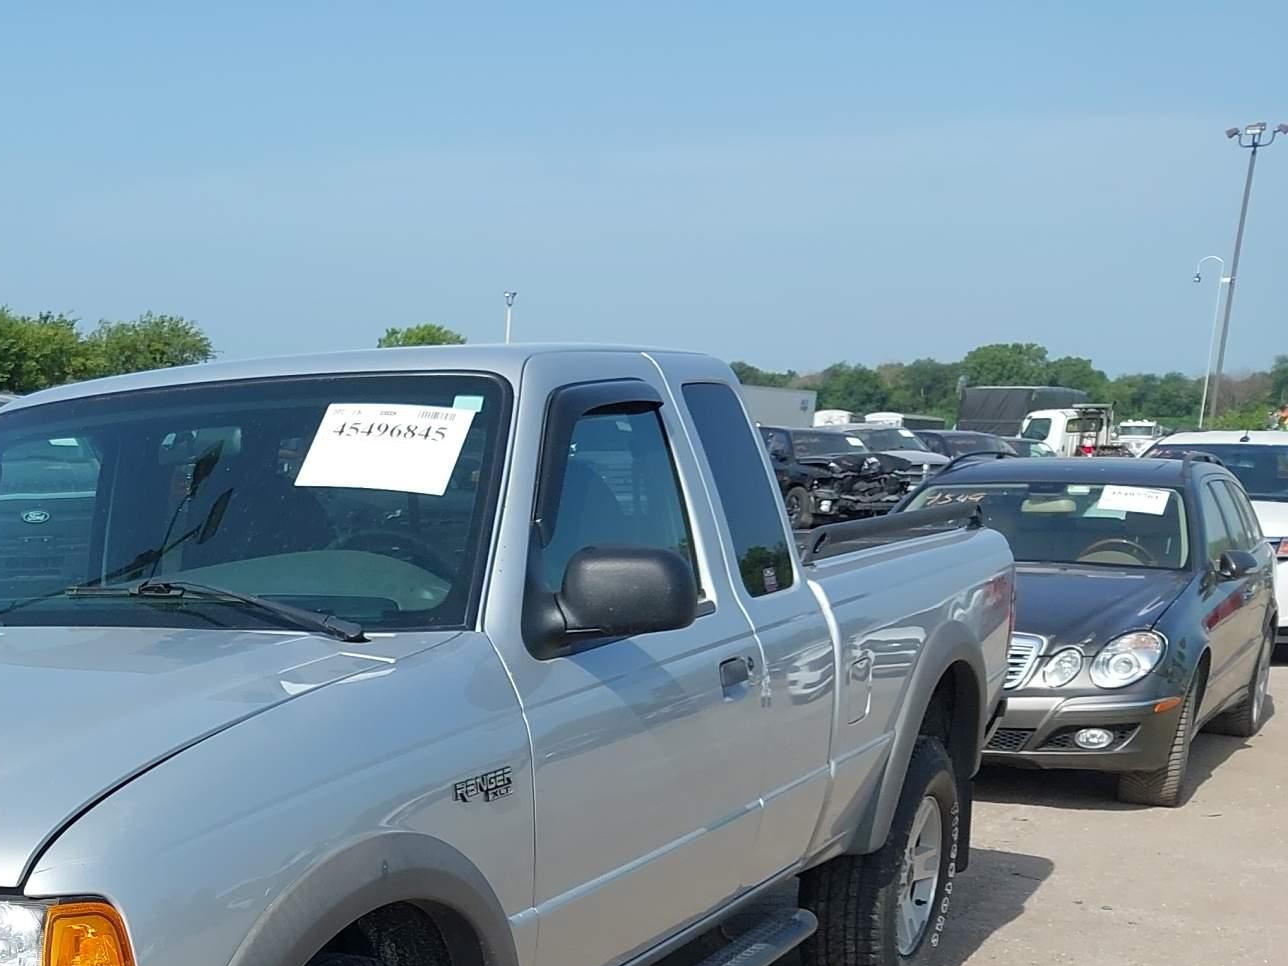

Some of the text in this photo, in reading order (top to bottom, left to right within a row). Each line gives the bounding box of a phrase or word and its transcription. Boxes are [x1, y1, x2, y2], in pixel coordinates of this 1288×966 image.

[333, 422, 448, 441] 45496845
[454, 766, 512, 802] RANGER
[491, 786, 512, 800] XLT
